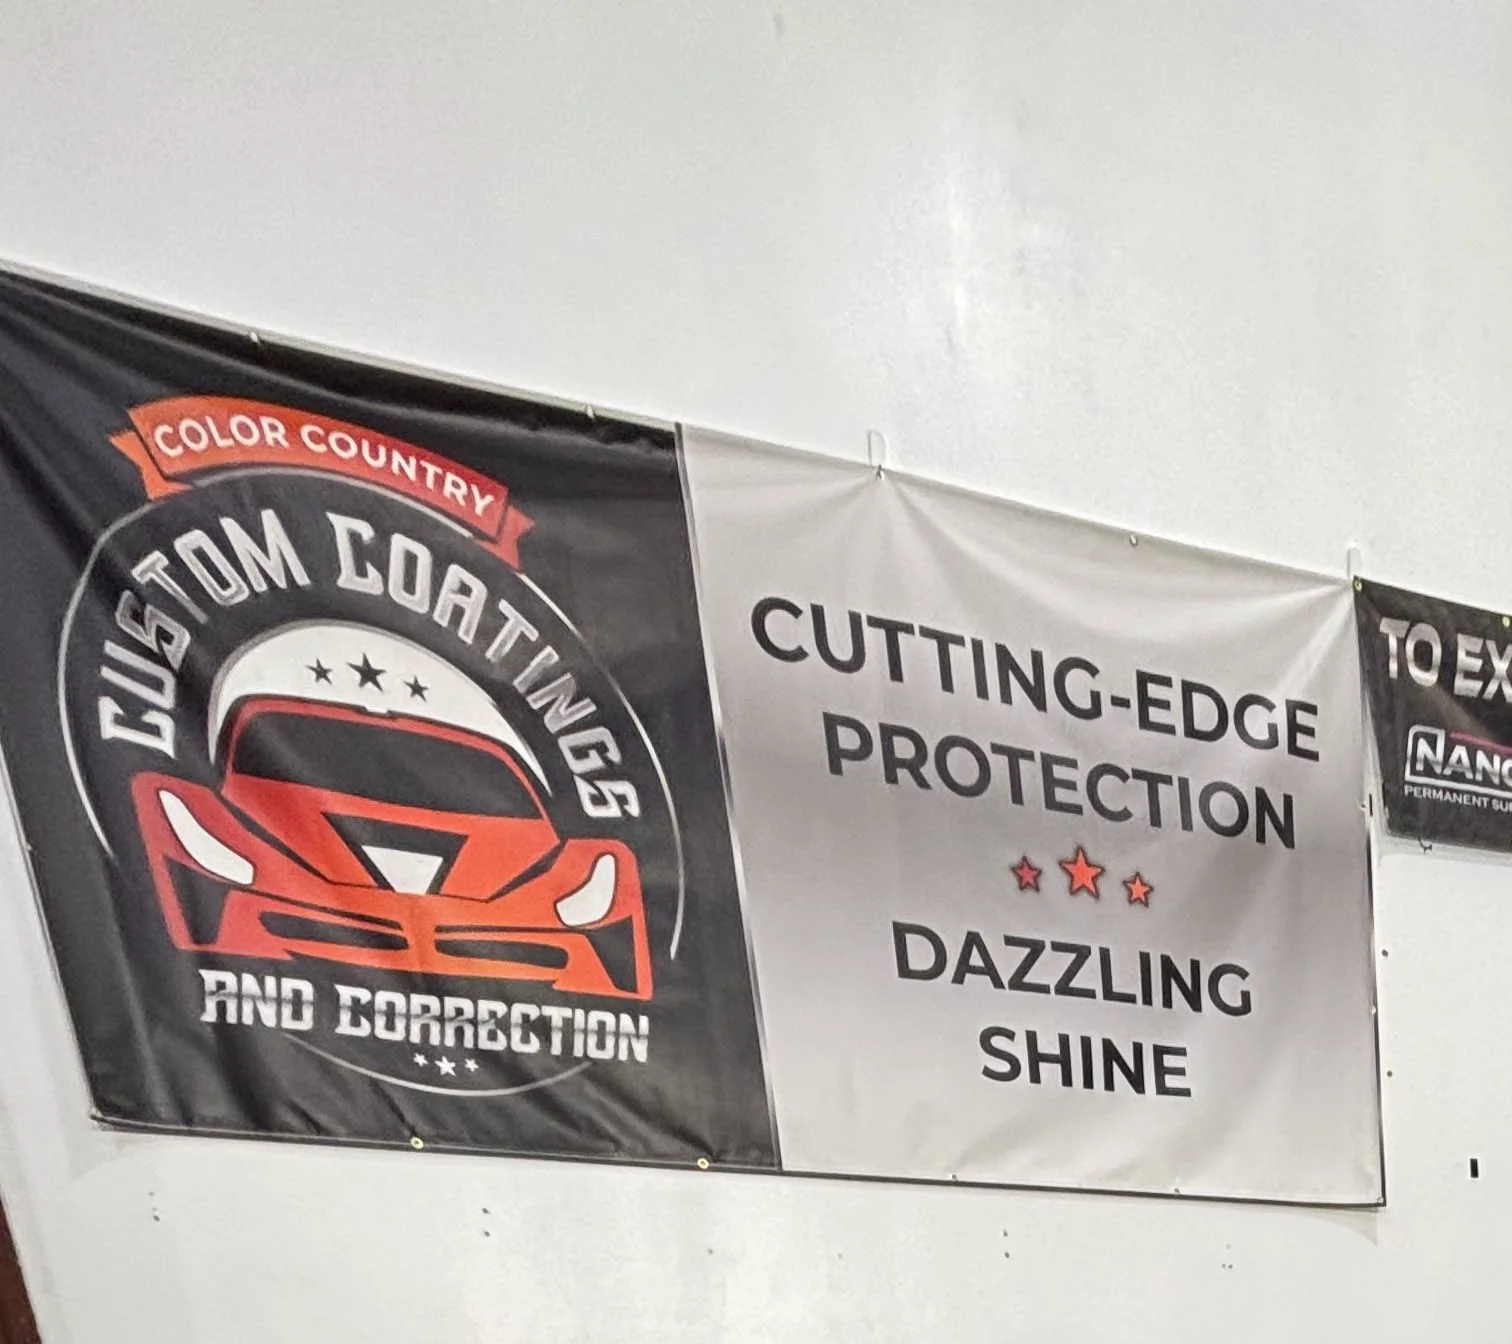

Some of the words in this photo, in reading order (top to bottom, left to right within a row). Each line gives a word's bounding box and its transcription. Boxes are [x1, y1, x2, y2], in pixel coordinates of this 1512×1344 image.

[154, 414, 290, 461] COLOR
[301, 426, 497, 517] COUNTRY
[99, 507, 310, 760] CUSTOM
[326, 510, 641, 820] COATINGS
[750, 597, 1320, 762] CUTTING-EDGE
[1379, 616, 1443, 688] TO
[821, 710, 1296, 850] PROTECTION
[1403, 784, 1489, 809] PERMANENT
[199, 968, 315, 1034] AND
[334, 984, 650, 1063] CORRECTION
[892, 920, 1252, 1017] DAZZLING
[978, 1025, 1192, 1098] SHINE
